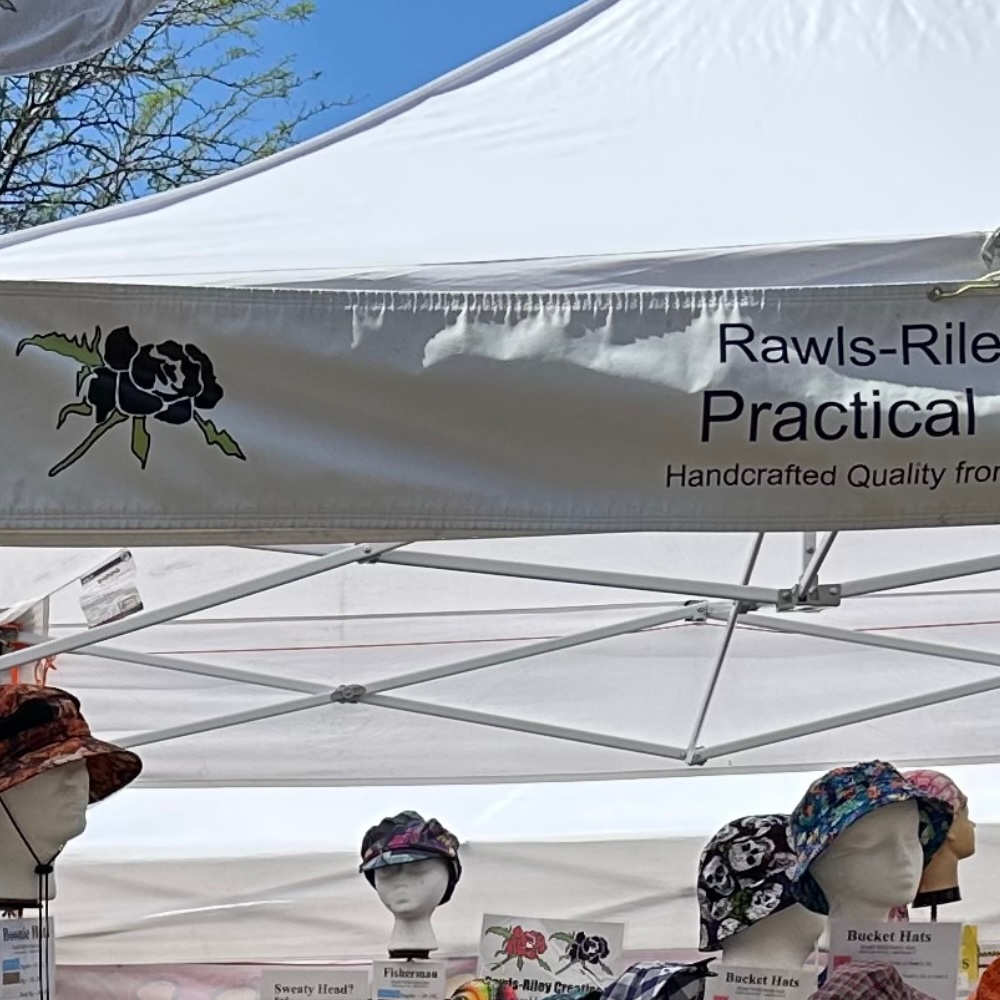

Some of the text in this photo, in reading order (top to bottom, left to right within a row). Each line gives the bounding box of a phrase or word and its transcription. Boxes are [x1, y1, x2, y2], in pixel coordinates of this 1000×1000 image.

[701, 388, 975, 443] Practical
[666, 463, 837, 488] Handcrafted
[847, 462, 946, 490] Quality
[847, 930, 932, 942] Bucket Hats
[383, 967, 438, 979] Fisherman
[725, 972, 800, 987] Bucket Hats
[274, 984, 354, 997] Sweaty Head?
